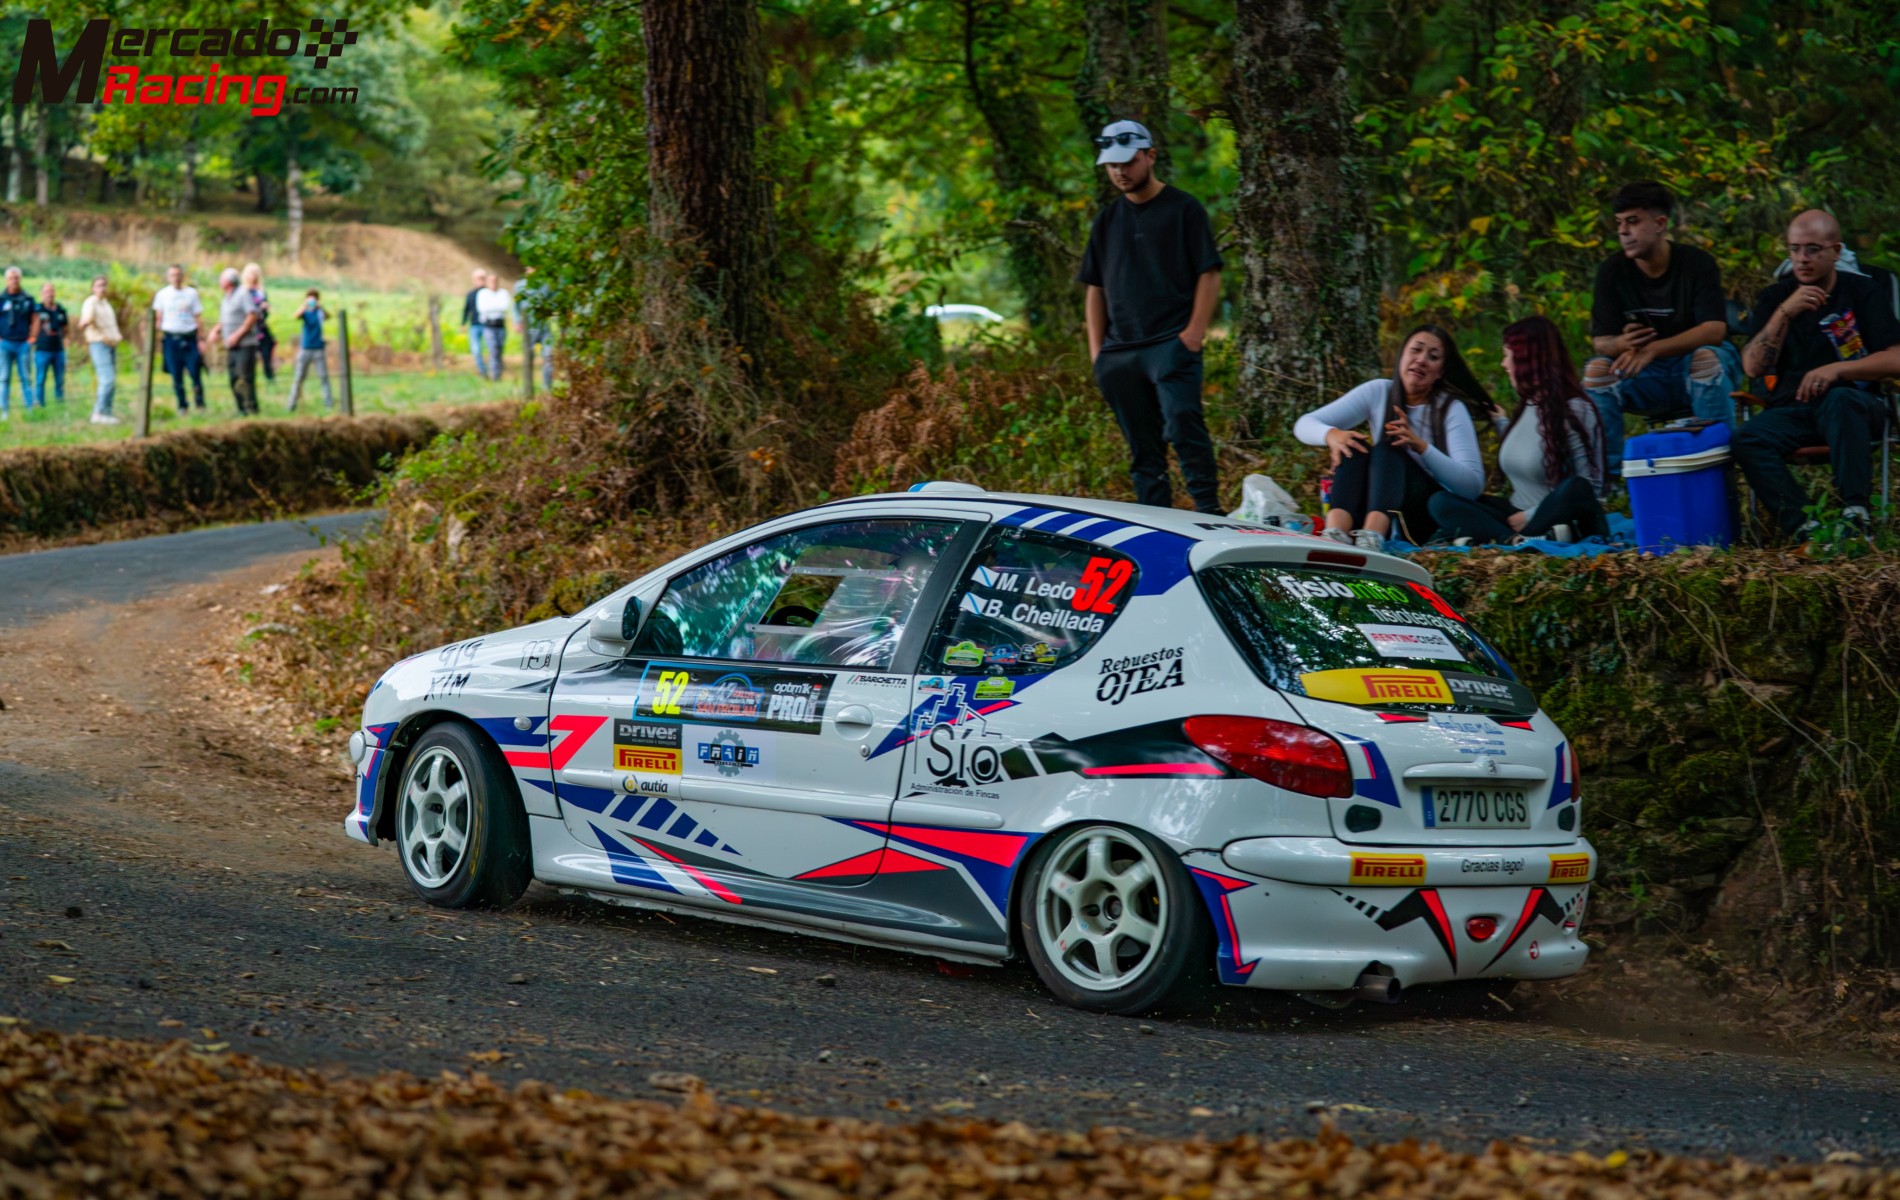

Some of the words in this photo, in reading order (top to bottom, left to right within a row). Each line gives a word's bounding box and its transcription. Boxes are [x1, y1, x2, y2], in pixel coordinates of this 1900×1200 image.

[995, 572, 1018, 591] M.
[1025, 577, 1076, 600] Ledo
[1072, 556, 1134, 615] 52
[984, 599, 1004, 618] B.
[1011, 603, 1105, 633] Cheillada
[1098, 646, 1184, 675] Repuestos
[860, 676, 908, 685] BARCHETTA
[1096, 659, 1185, 706] OJEA
[1361, 675, 1444, 699] PIRELLI
[651, 671, 689, 715] 52
[619, 749, 677, 771] PIRELLI
[640, 779, 668, 793] autia
[911, 782, 963, 796] Administración
[965, 789, 974, 797] de
[975, 789, 1000, 800] Fincas
[1437, 790, 1489, 823] 2770
[1494, 791, 1526, 823] CGS
[1353, 858, 1425, 878] PIRELLI
[1461, 858, 1499, 873] Gracias
[1550, 858, 1590, 879] PIRELLI
